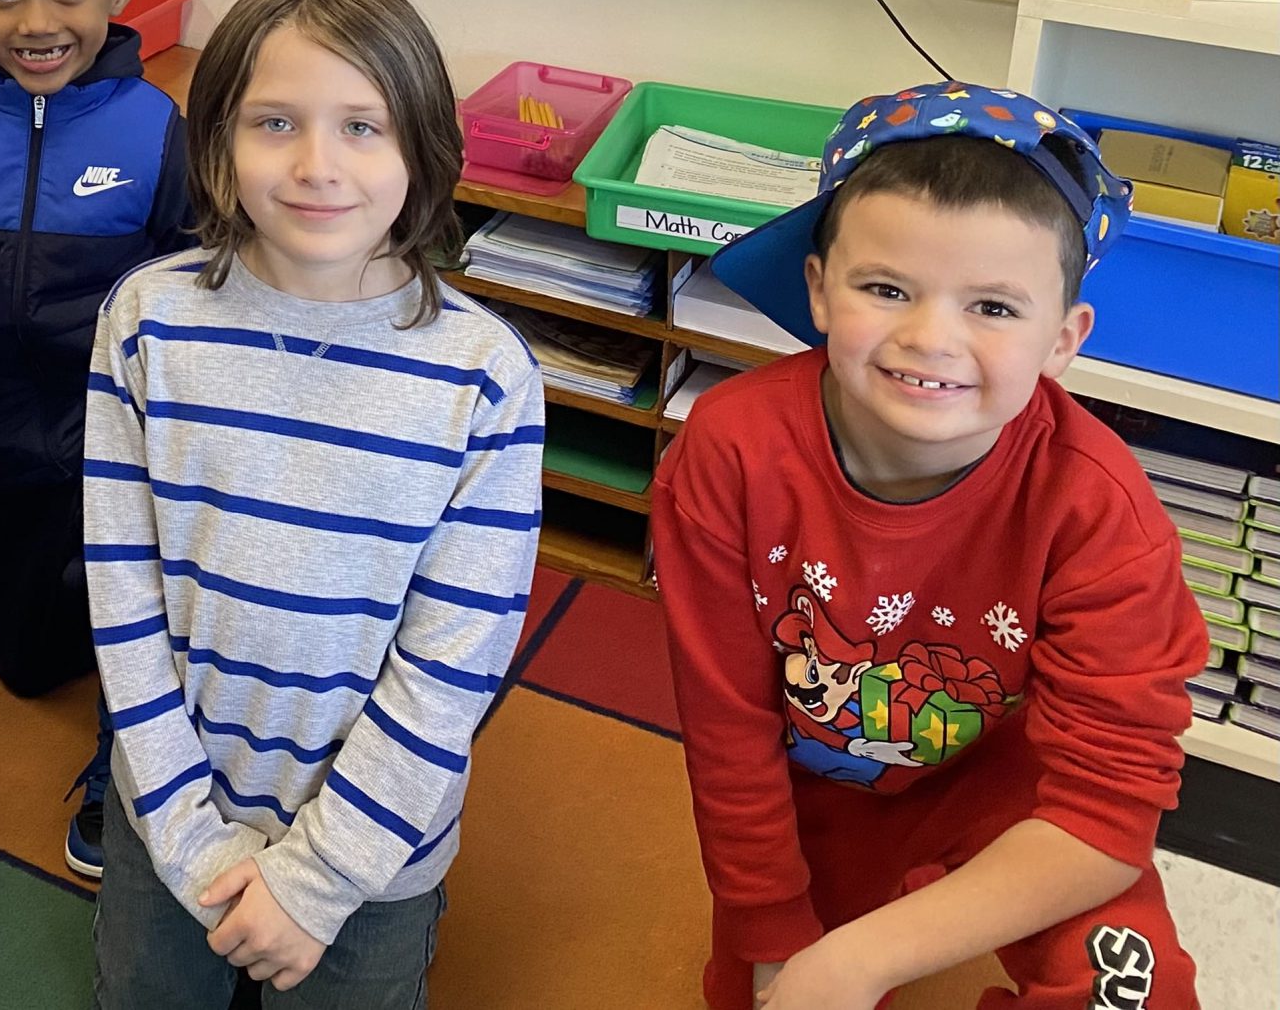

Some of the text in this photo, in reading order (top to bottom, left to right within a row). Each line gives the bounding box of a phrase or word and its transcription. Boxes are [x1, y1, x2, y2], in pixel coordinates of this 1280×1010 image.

[1243, 154, 1263, 168] 12
[82, 165, 121, 186] NIKE
[646, 210, 700, 236] Math
